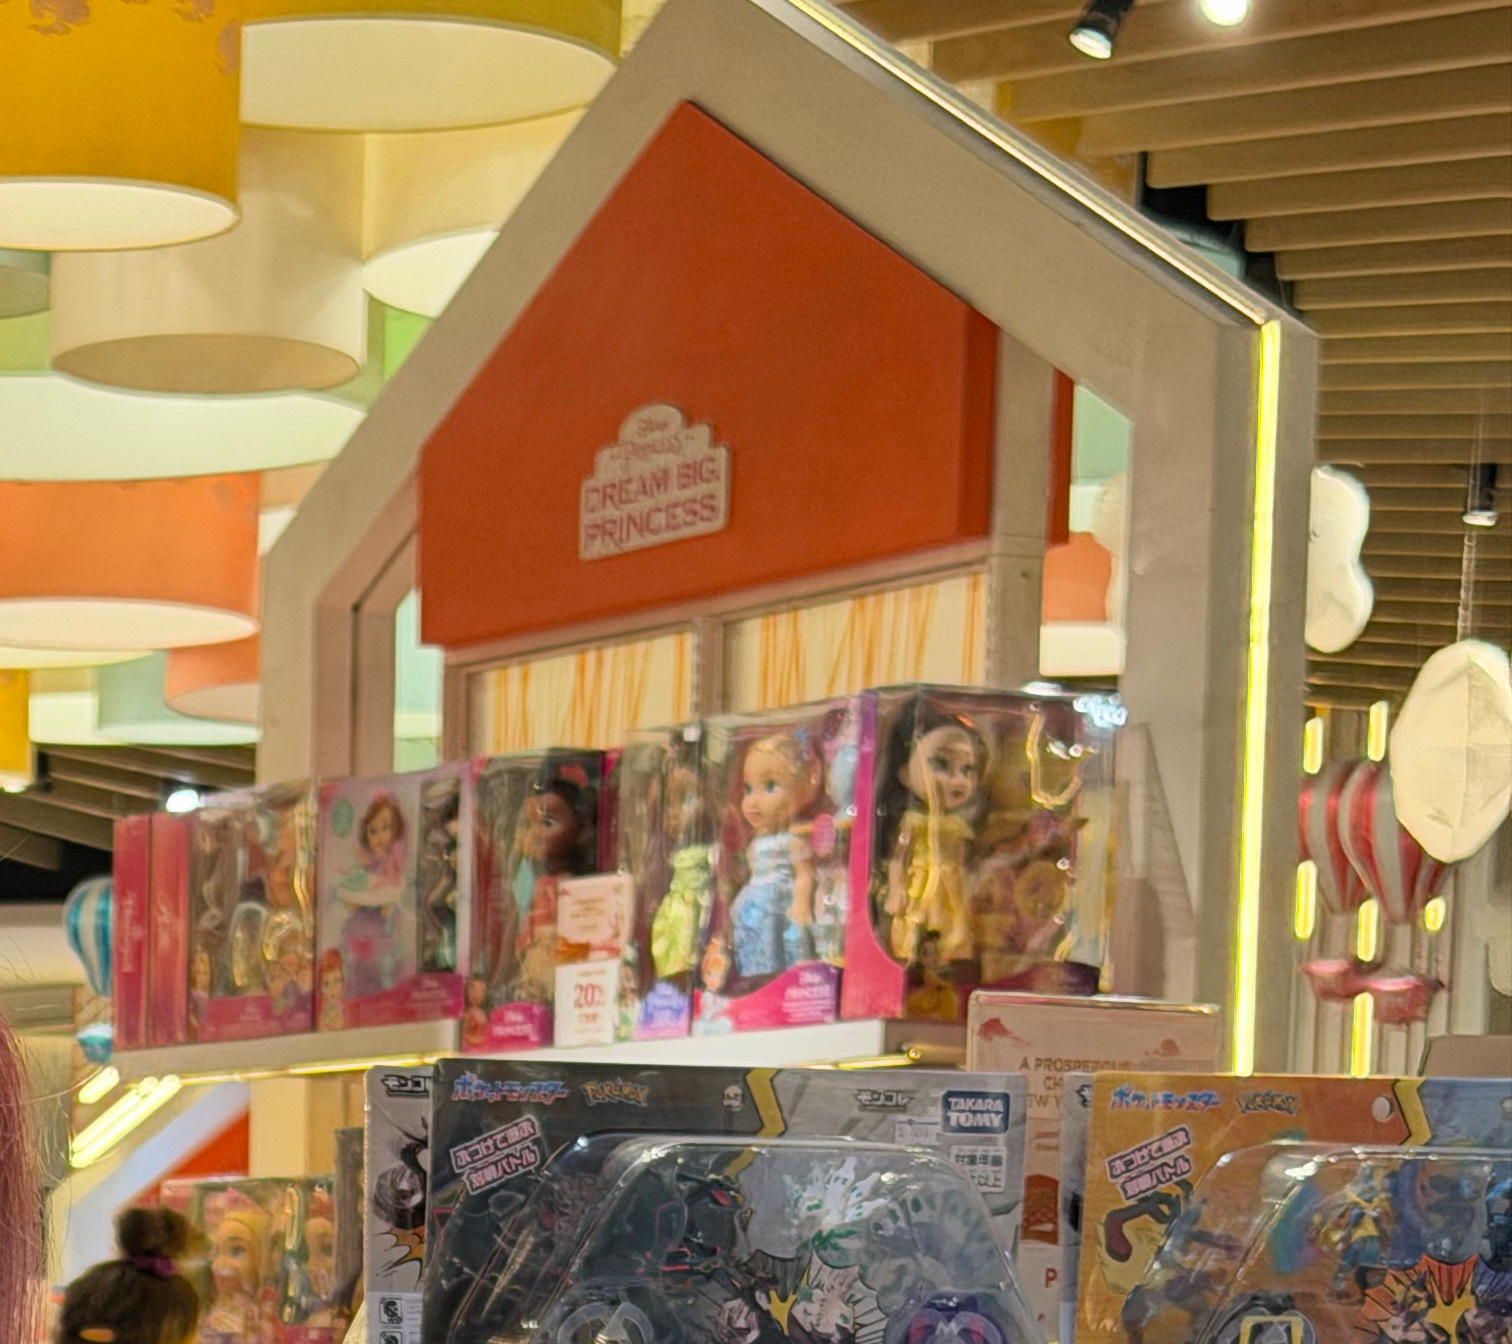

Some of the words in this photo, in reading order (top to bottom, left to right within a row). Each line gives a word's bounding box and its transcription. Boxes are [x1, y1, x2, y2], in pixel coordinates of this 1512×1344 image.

[585, 466, 670, 514] DREAM
[676, 457, 716, 491] BIG
[584, 493, 719, 549] PRINCESS
[1020, 1058, 1029, 1071] A
[383, 1075, 431, 1096] モンコ
[947, 1098, 1004, 1111] TAKARA
[947, 1111, 1004, 1127] TOMY
